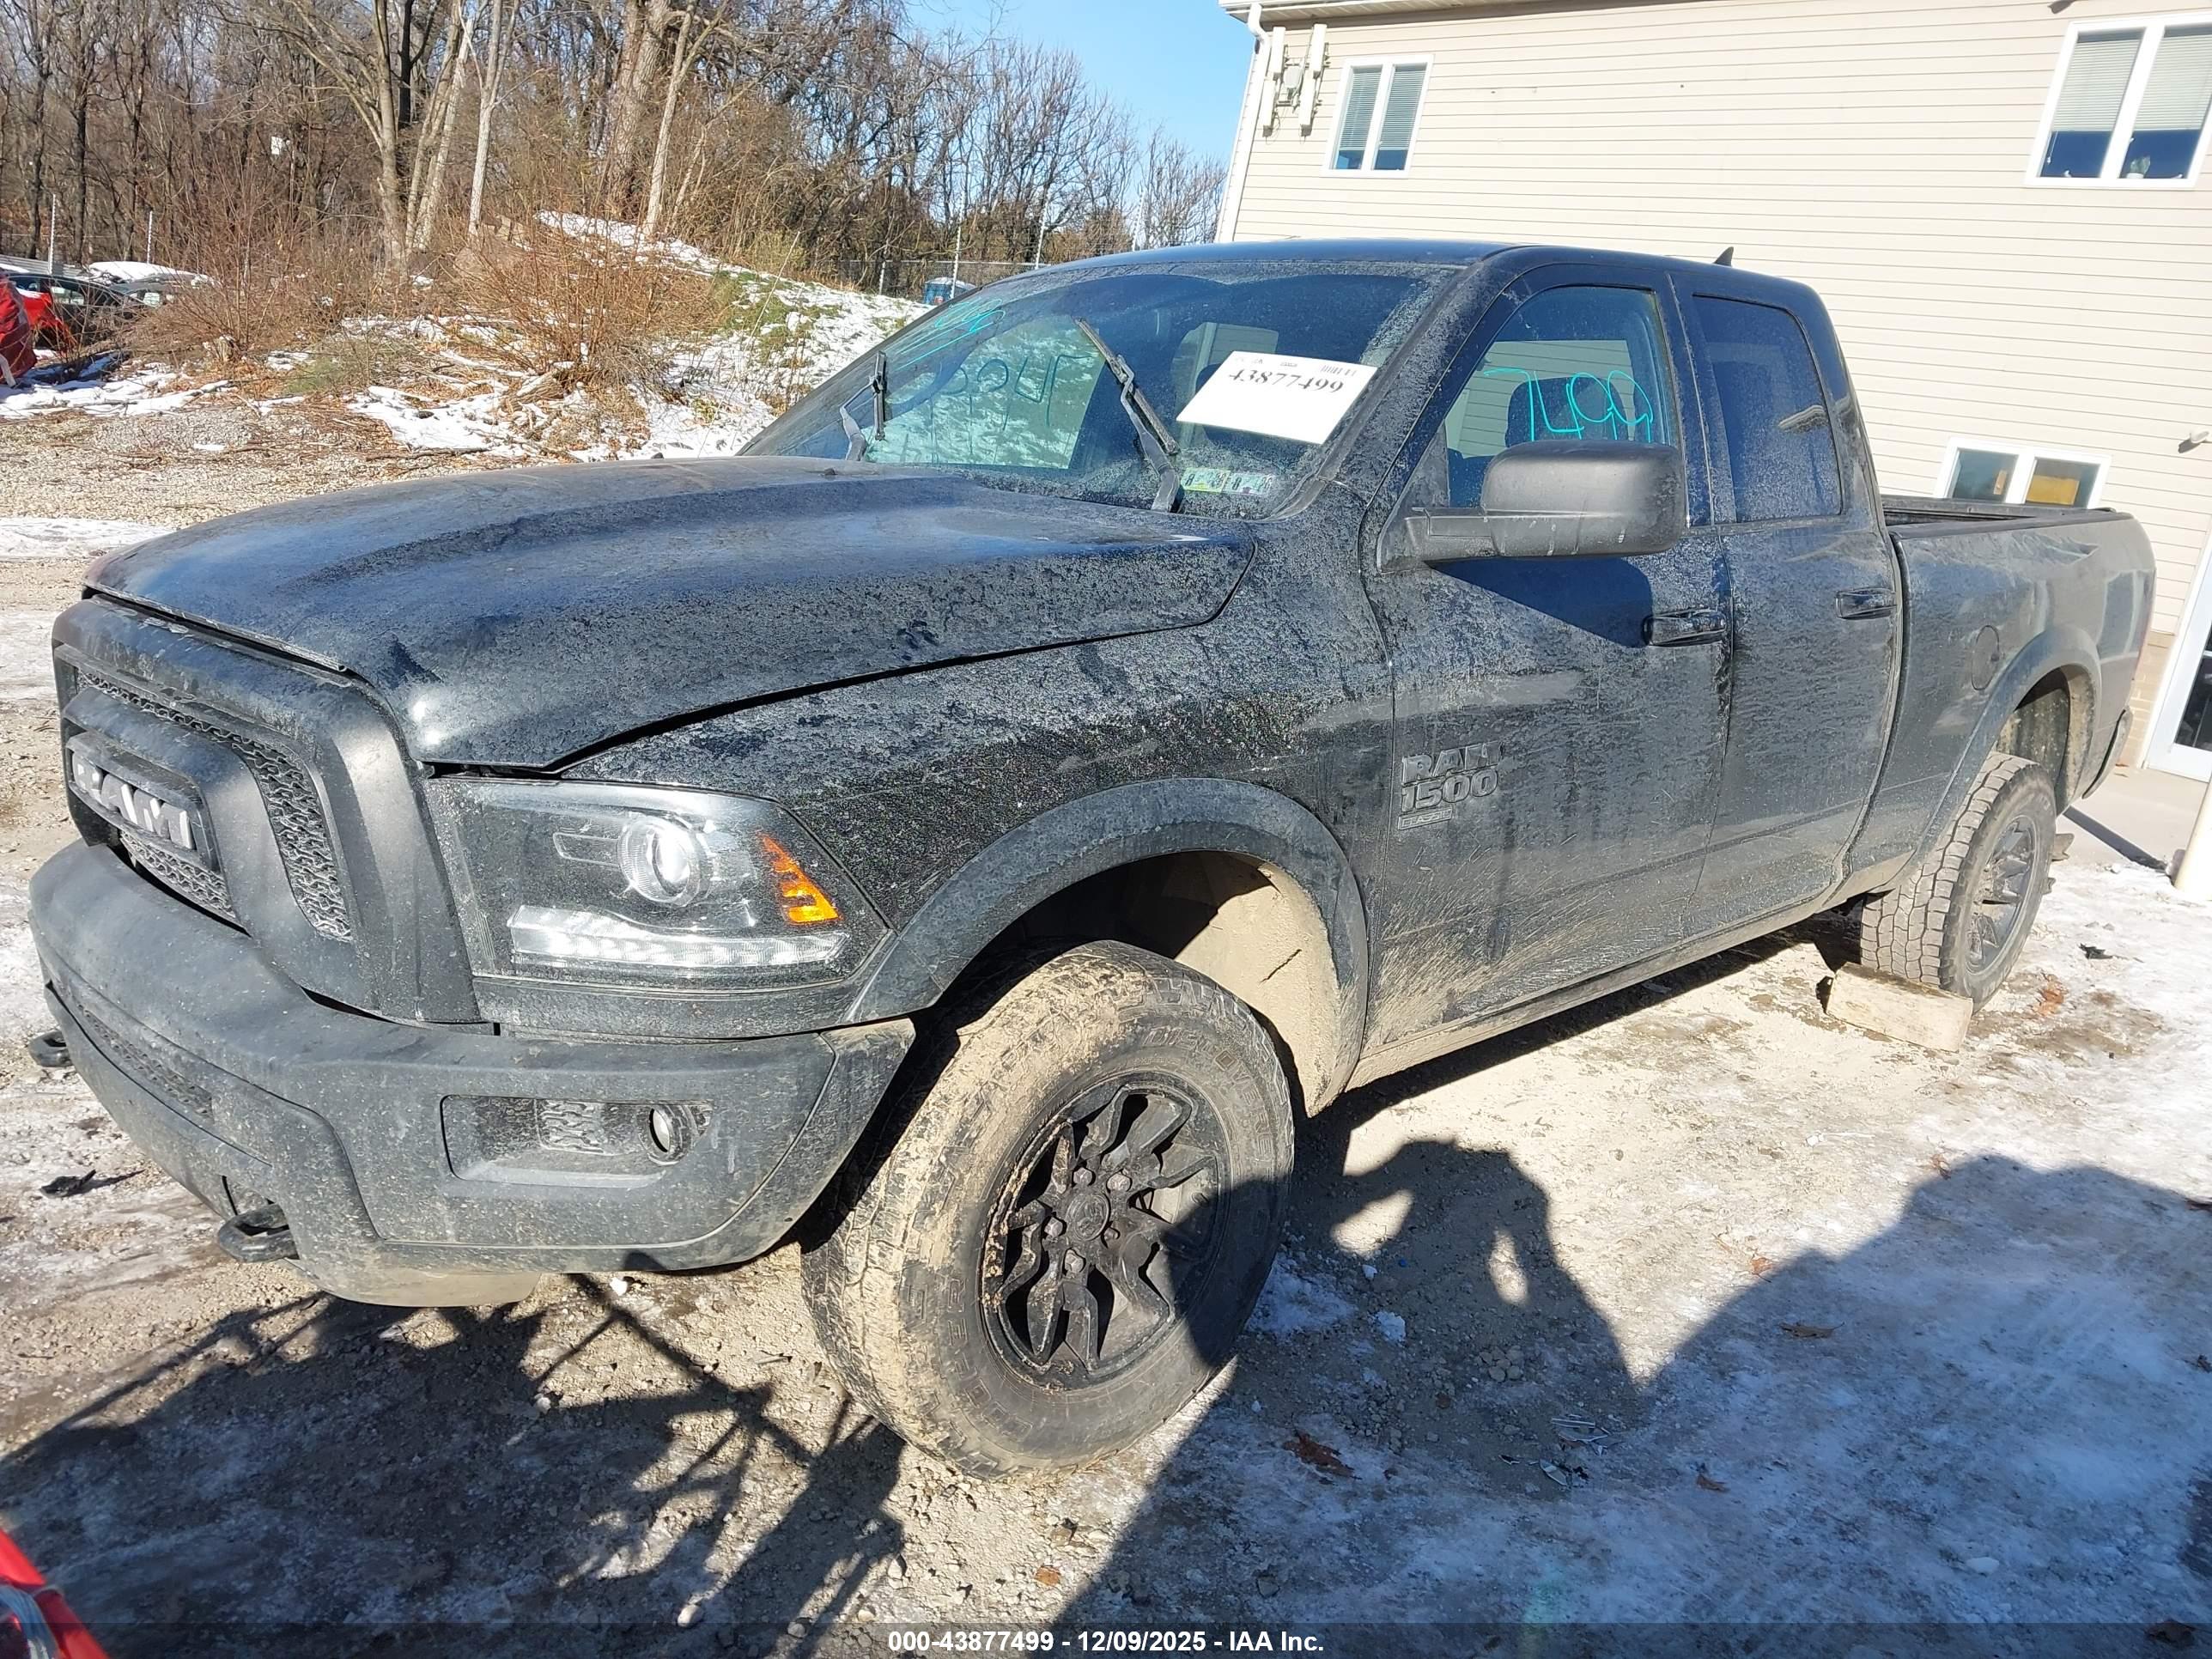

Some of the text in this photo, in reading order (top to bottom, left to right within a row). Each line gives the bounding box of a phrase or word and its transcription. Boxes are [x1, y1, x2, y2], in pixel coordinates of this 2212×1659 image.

[1229, 368, 1345, 393] 43877499
[1402, 742, 1501, 782] RAM
[71, 750, 194, 849] RAM
[1401, 769, 1498, 810] 1500
